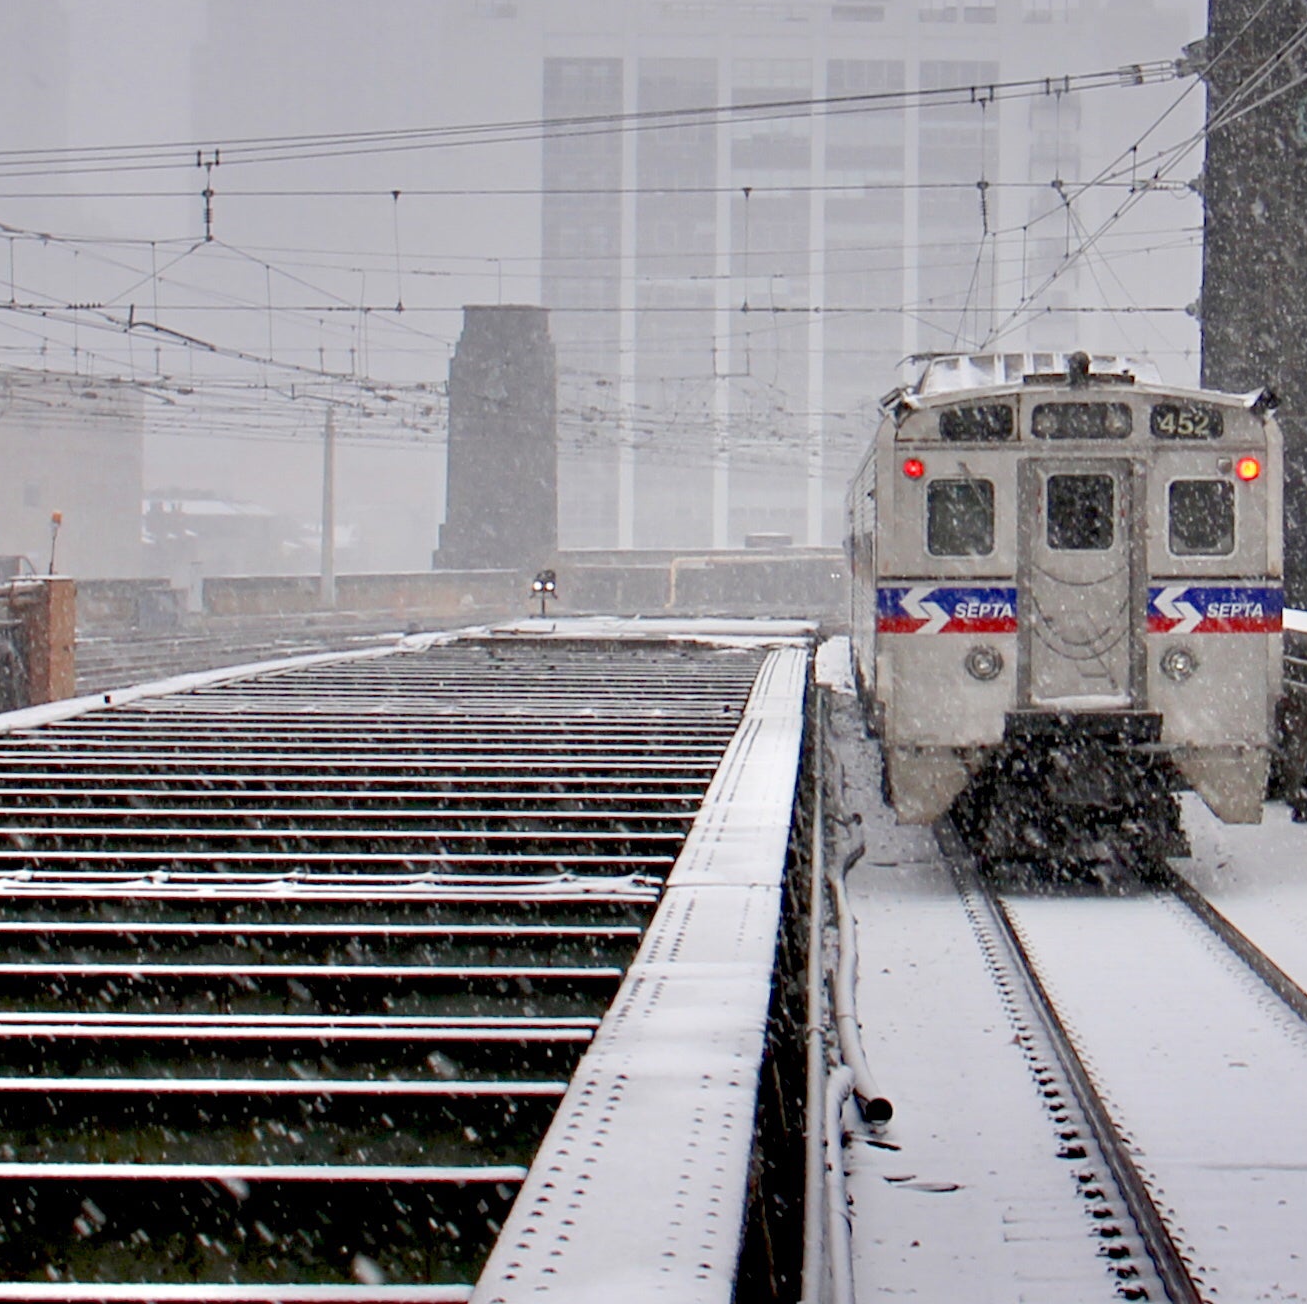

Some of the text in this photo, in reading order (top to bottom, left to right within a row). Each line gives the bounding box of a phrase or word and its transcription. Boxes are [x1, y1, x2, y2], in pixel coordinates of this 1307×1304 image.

[1160, 413, 1209, 435] 452
[954, 602, 1014, 618] SEPTA
[1207, 602, 1265, 618] SEPTA
